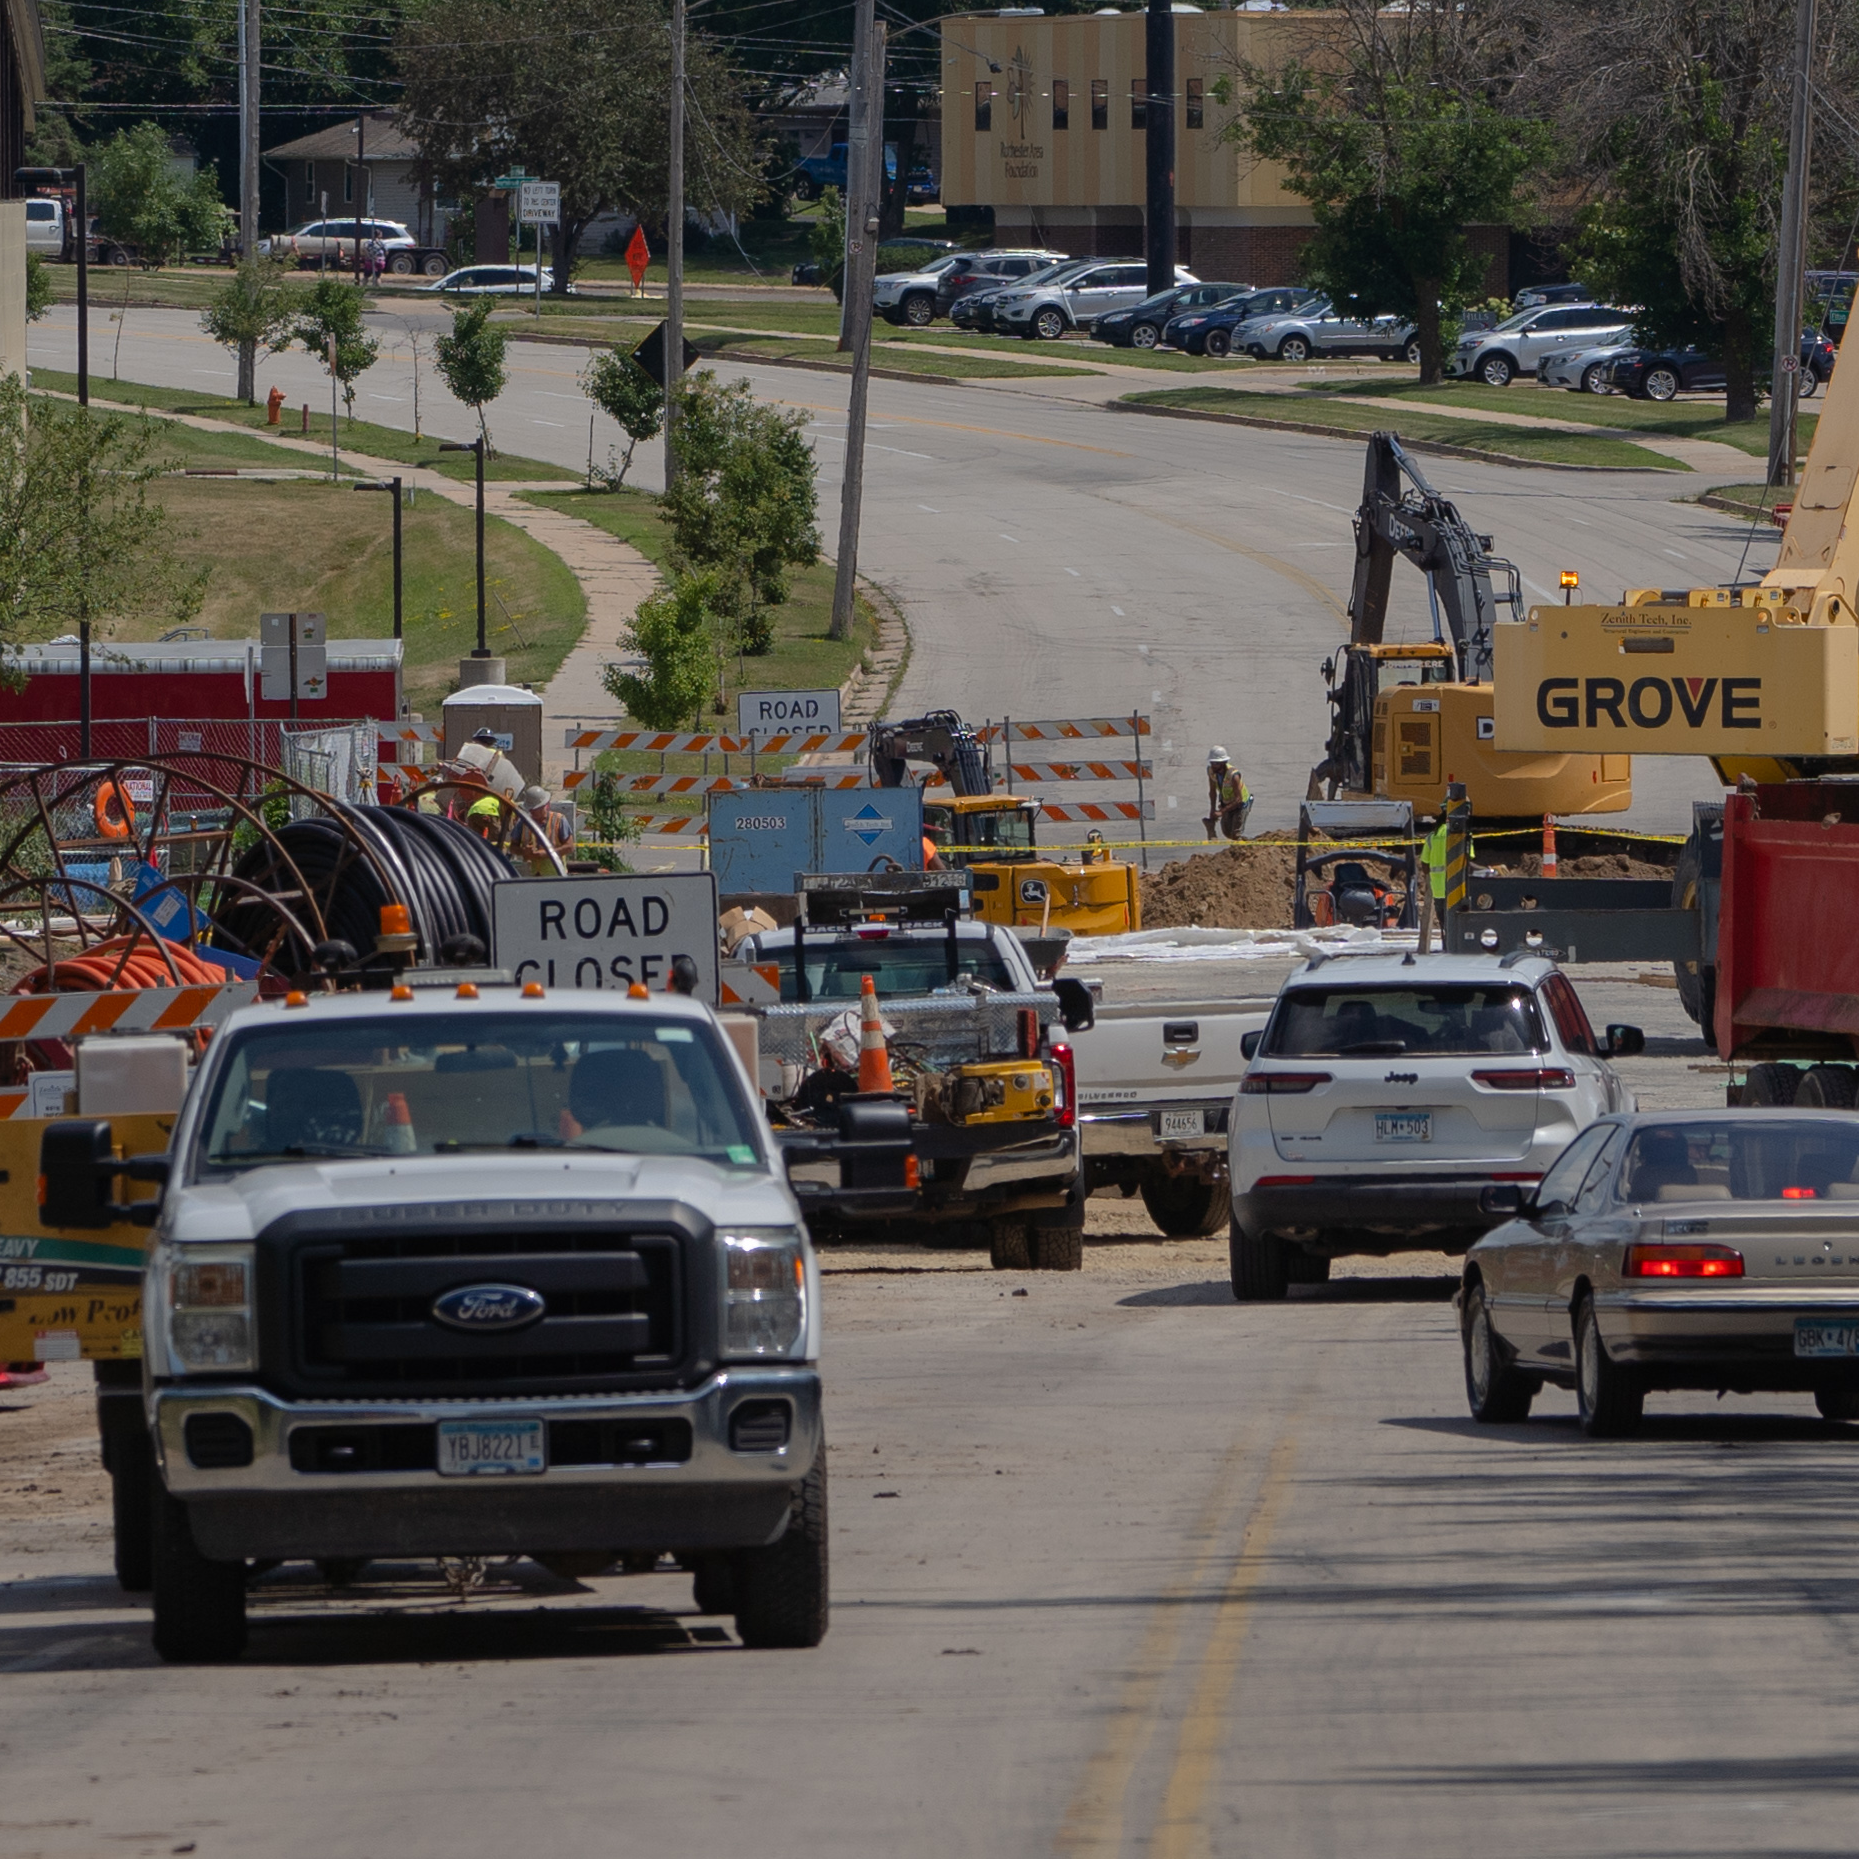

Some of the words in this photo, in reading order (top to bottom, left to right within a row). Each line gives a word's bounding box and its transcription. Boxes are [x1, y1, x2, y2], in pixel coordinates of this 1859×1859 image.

[1671, 614, 1692, 625] Inc.
[758, 700, 820, 720] ROAD
[1537, 676, 1762, 729] GROVE
[735, 816, 786, 830] 280503
[540, 895, 669, 941] ROAD
[901, 920, 944, 929] RACK
[804, 926, 848, 934] BACK
[1384, 1071, 1419, 1085] Jeep
[1164, 1117, 1198, 1132] 944656
[3, 1267, 43, 1289] 855
[44, 1271, 80, 1292] SDT
[457, 1291, 518, 1320] Ford
